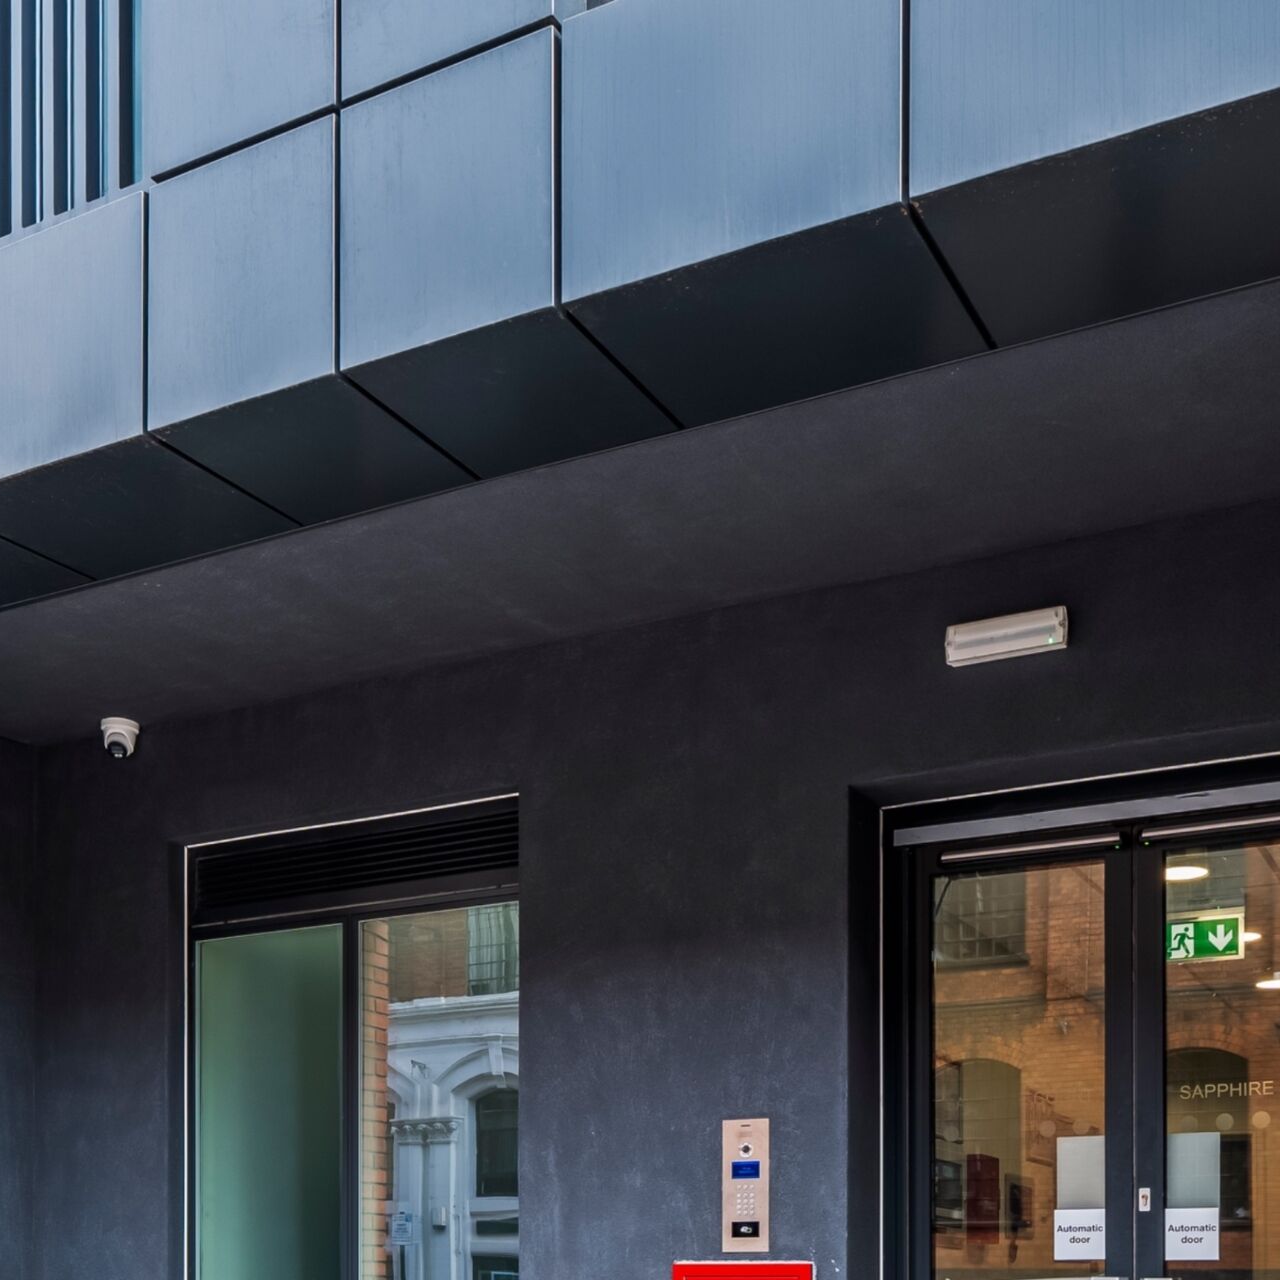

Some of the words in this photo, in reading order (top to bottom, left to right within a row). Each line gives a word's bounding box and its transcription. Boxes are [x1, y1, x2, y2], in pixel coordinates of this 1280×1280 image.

[1179, 1080, 1274, 1100] SAPPHIRE
[1056, 1224, 1104, 1233] Automatic
[1167, 1224, 1217, 1233] Automatic
[1069, 1235, 1091, 1244] door
[1180, 1235, 1204, 1244] door
